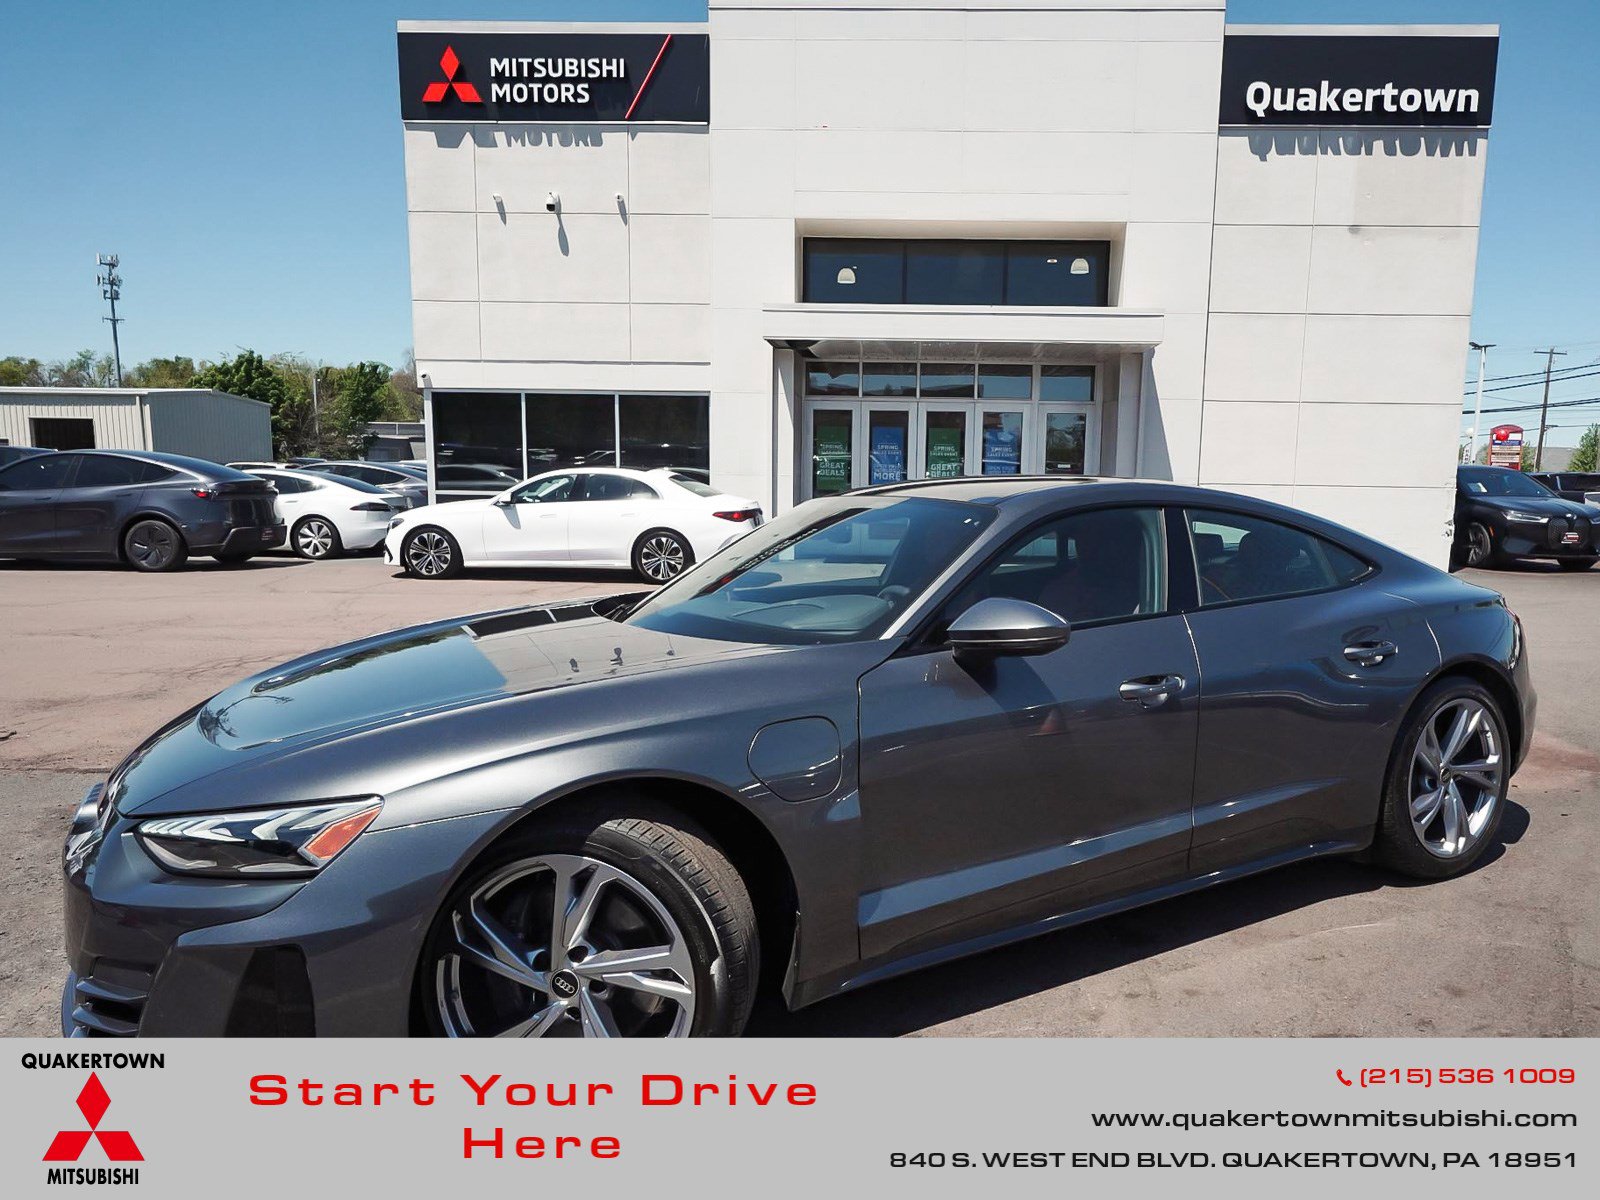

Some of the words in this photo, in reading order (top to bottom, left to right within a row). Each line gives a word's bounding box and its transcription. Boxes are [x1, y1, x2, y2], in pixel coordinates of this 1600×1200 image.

[489, 57, 626, 79] MITSUBISHI
[490, 82, 590, 104] MOTORS
[1245, 80, 1480, 118] Quakertown
[873, 472, 901, 481] MORE
